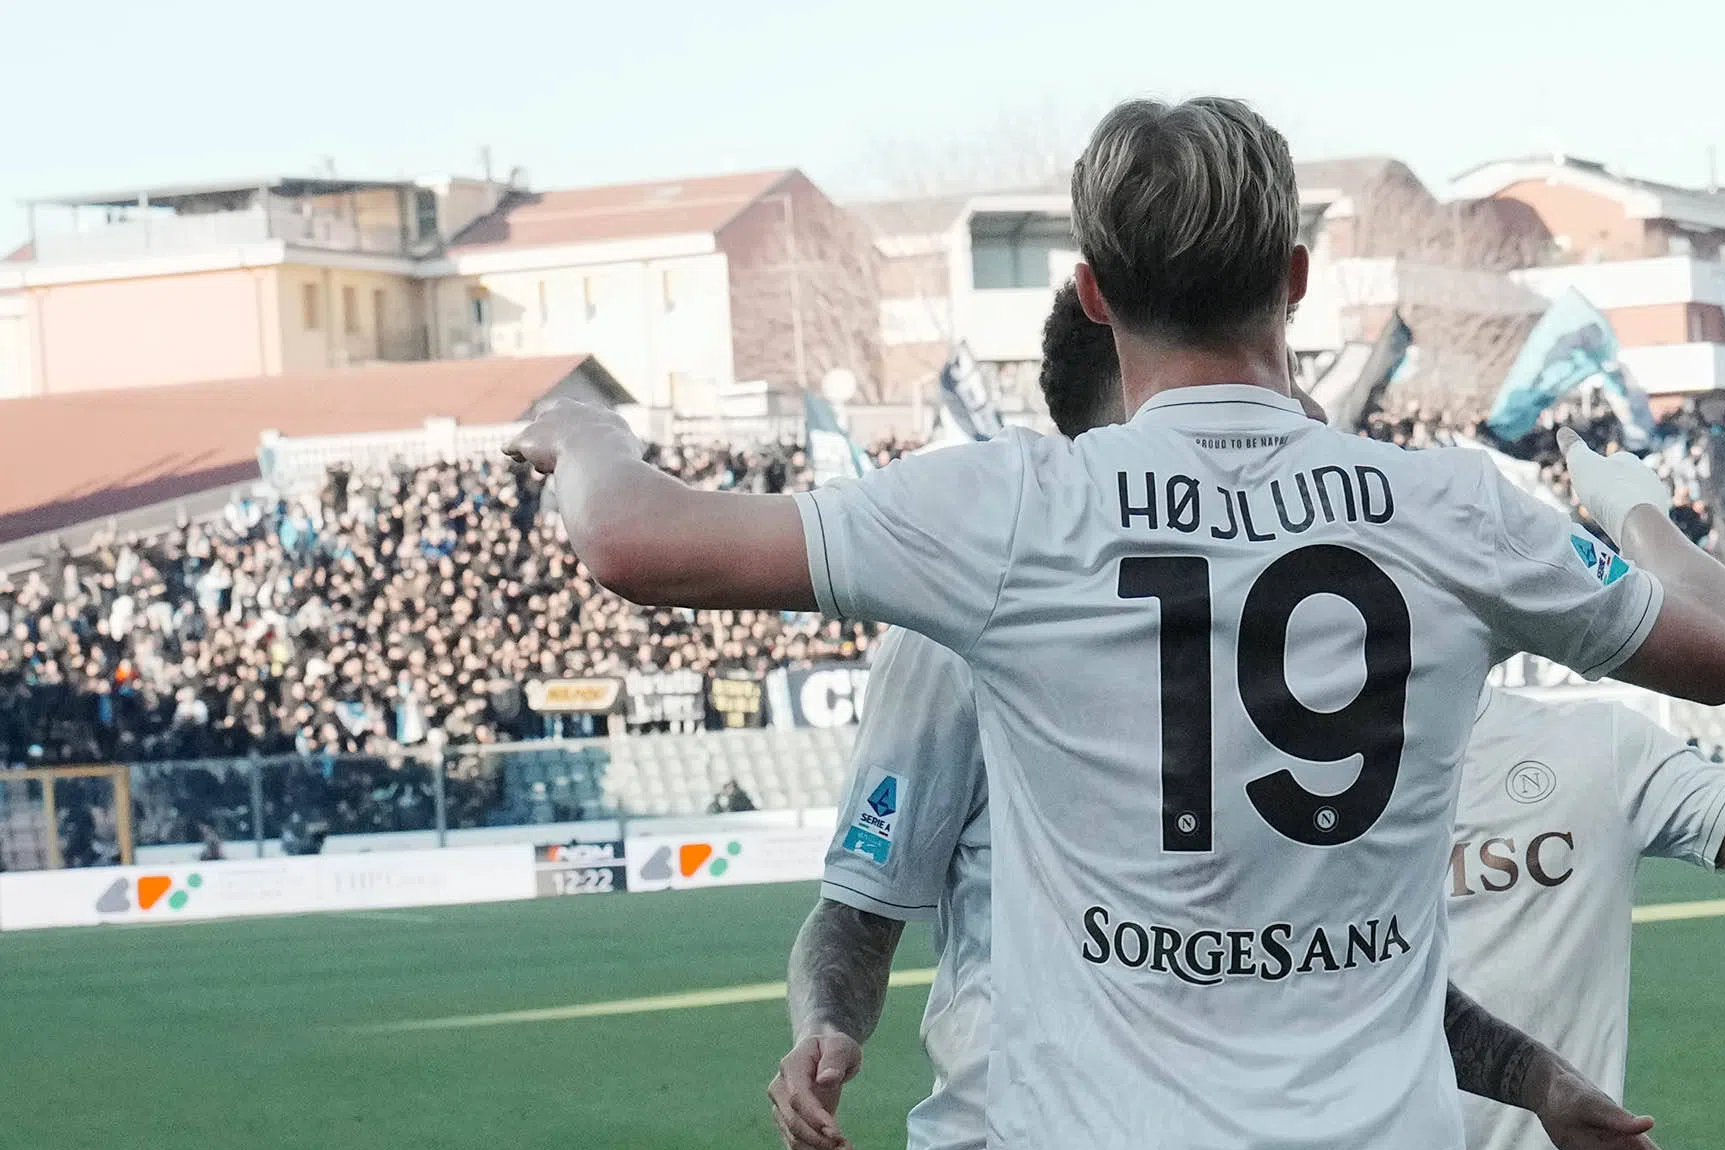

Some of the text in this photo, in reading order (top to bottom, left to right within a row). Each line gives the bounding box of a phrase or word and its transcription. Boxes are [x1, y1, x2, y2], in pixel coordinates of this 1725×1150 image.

[1231, 439, 1242, 449] TO
[1246, 437, 1257, 448] BE
[1117, 465, 1394, 542] HØJLUND
[1117, 544, 1411, 853] 19
[1519, 772, 1541, 794] N
[860, 813, 891, 832] SERIE A
